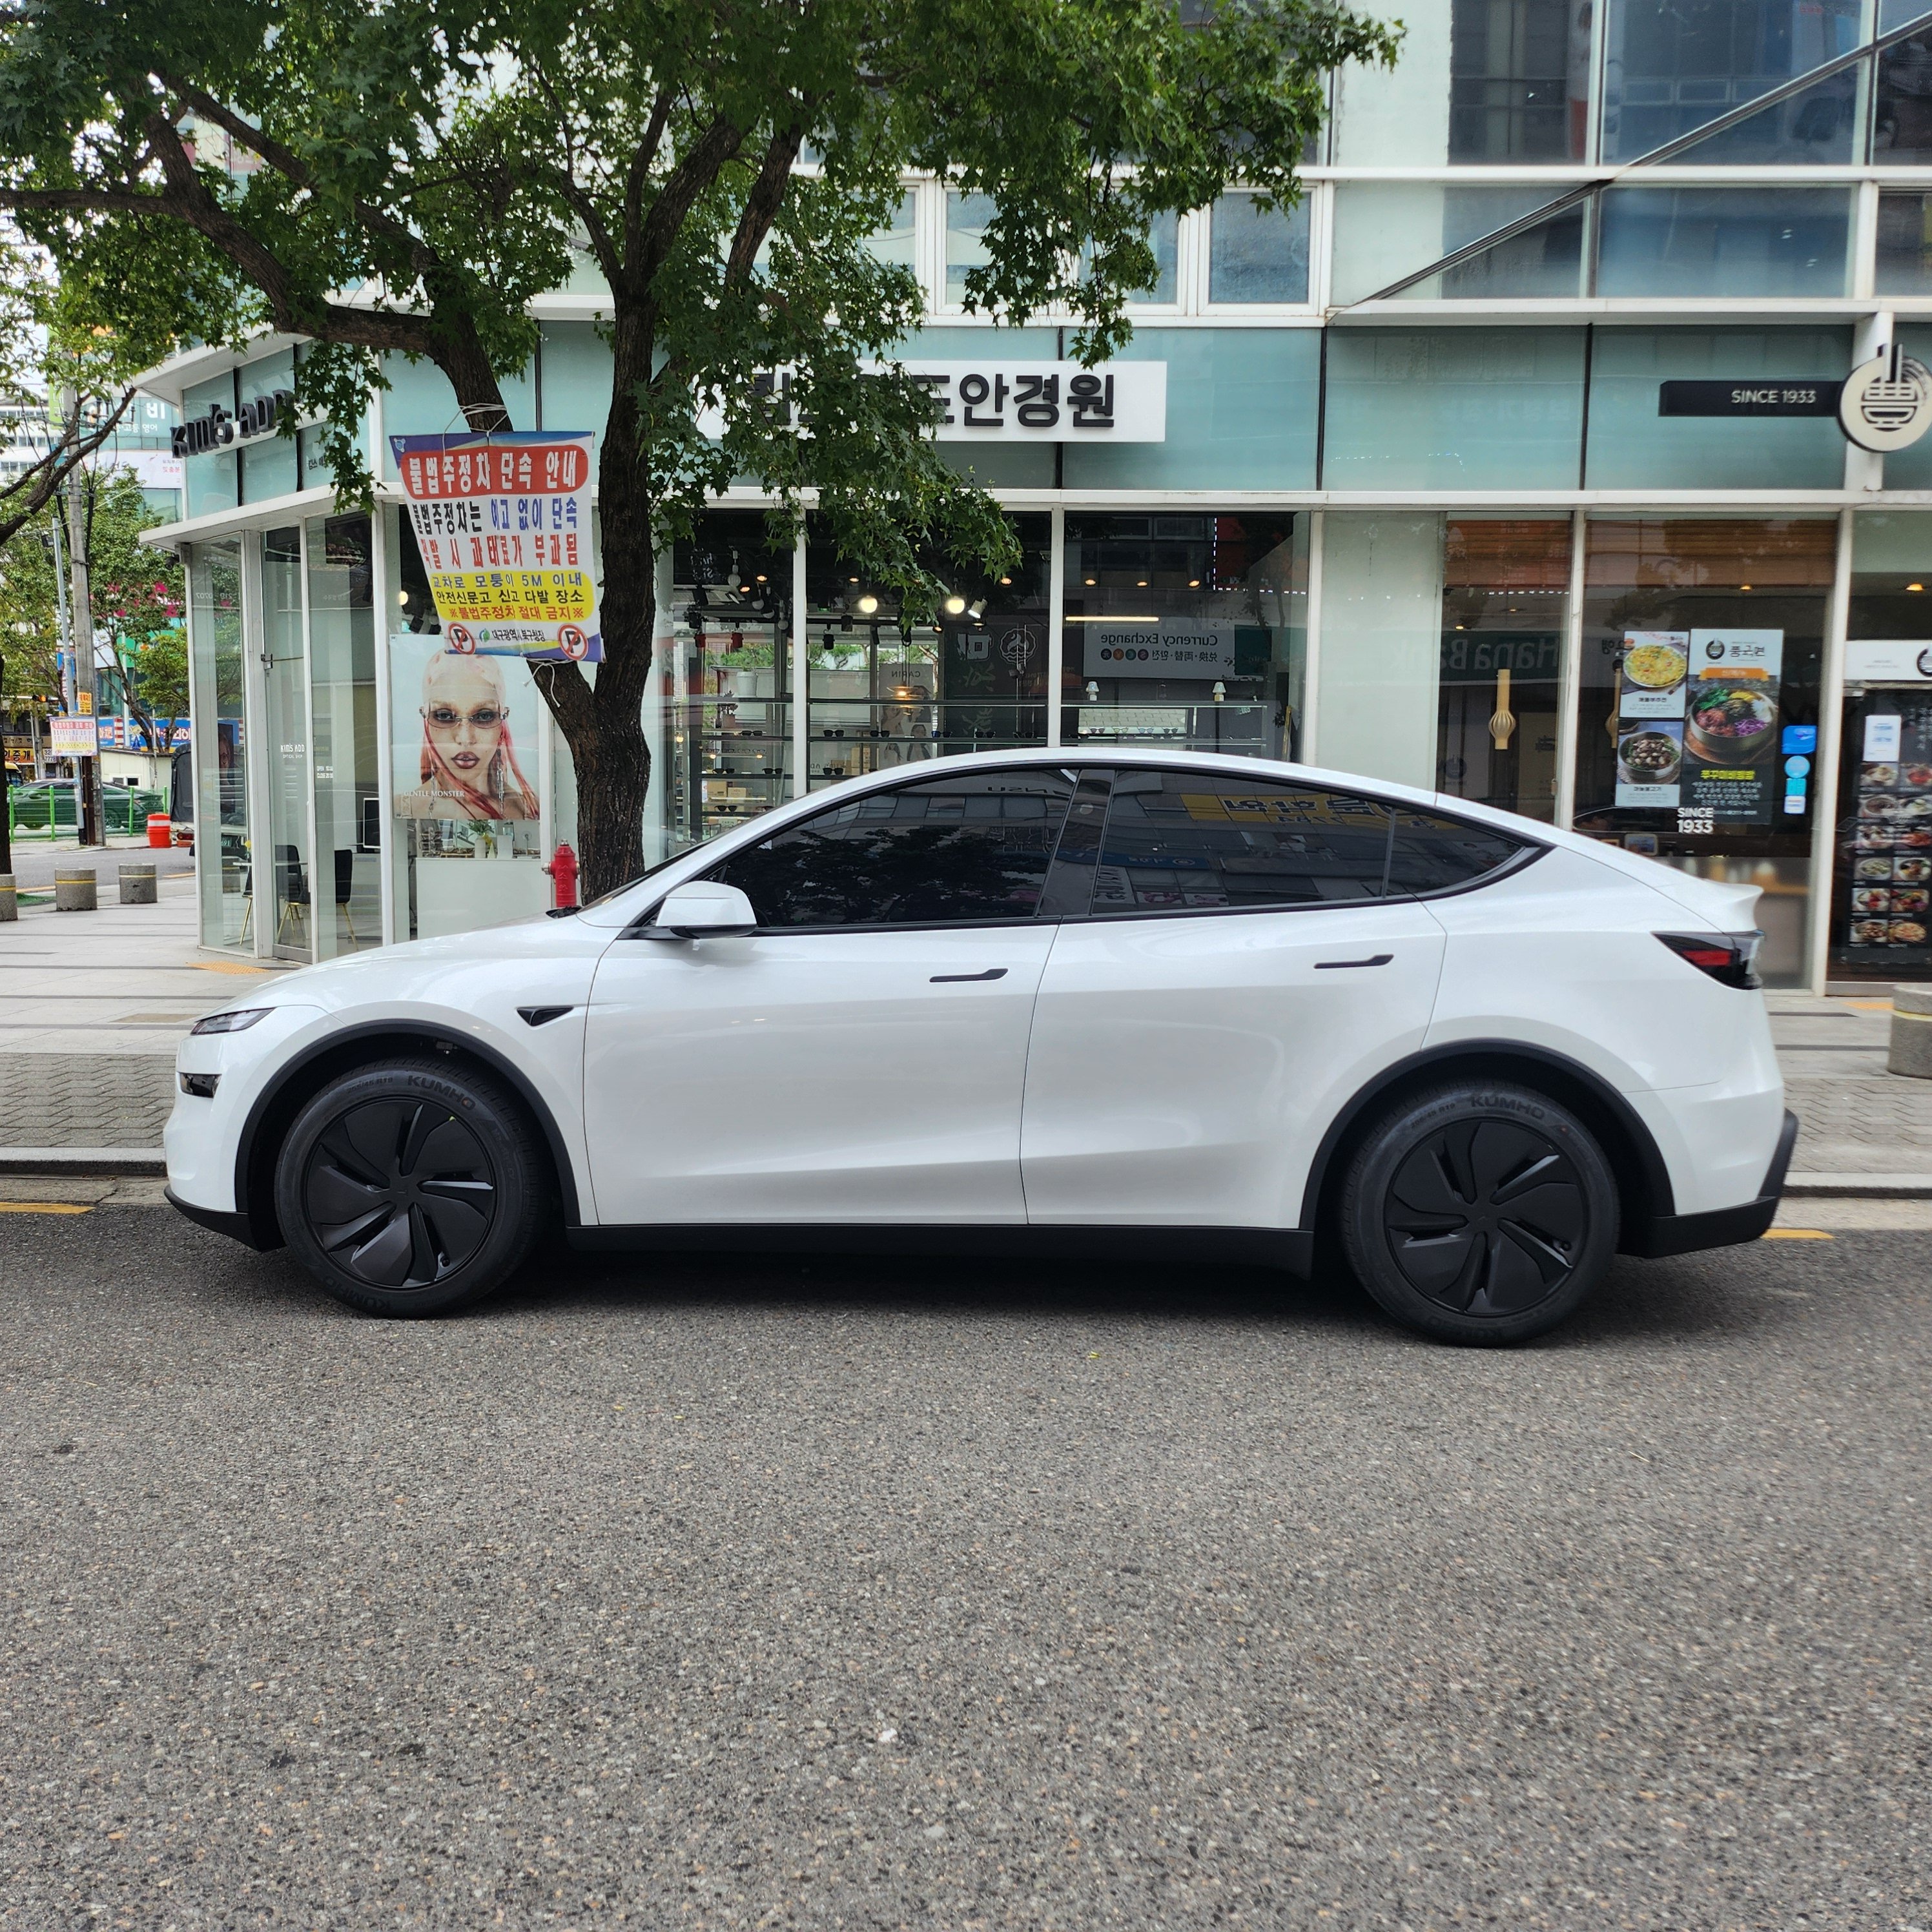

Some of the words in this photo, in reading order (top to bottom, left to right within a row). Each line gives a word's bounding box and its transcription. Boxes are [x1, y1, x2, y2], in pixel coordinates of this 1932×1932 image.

[1731, 389, 1778, 404] SINCE
[1782, 389, 1817, 404] 1933
[142, 423, 158, 433] 영어
[409, 451, 491, 495] 불법주정차
[500, 452, 532, 490] 단속
[546, 450, 577, 489] 안내
[413, 500, 482, 535] 불법주정차는
[491, 498, 510, 531] 예고
[518, 497, 542, 531] 없이
[552, 497, 577, 529] 단속
[451, 538, 462, 570] 시
[470, 534, 523, 568] 과태료가
[535, 533, 579, 567] 부과됨
[432, 575, 466, 589] 교차로
[475, 573, 515, 588] 모퉁이
[522, 575, 542, 586] 5M
[553, 572, 582, 587] 이내
[436, 591, 492, 605] 안전신문고
[498, 590, 520, 604] 신고
[525, 590, 550, 604] 다발
[555, 589, 584, 604] 장소
[519, 606, 541, 620] 절대
[1729, 645, 1766, 657] 풍국면
[4, 750, 31, 761] 인중개
[294, 744, 305, 752] ADD
[403, 789, 430, 797] GENTLE
[432, 790, 465, 798] MONSTER
[1677, 807, 1714, 818] SINCE
[1676, 819, 1714, 834] 1933
[407, 1075, 476, 1111] KUMHO
[1470, 1095, 1546, 1120] KUMHO
